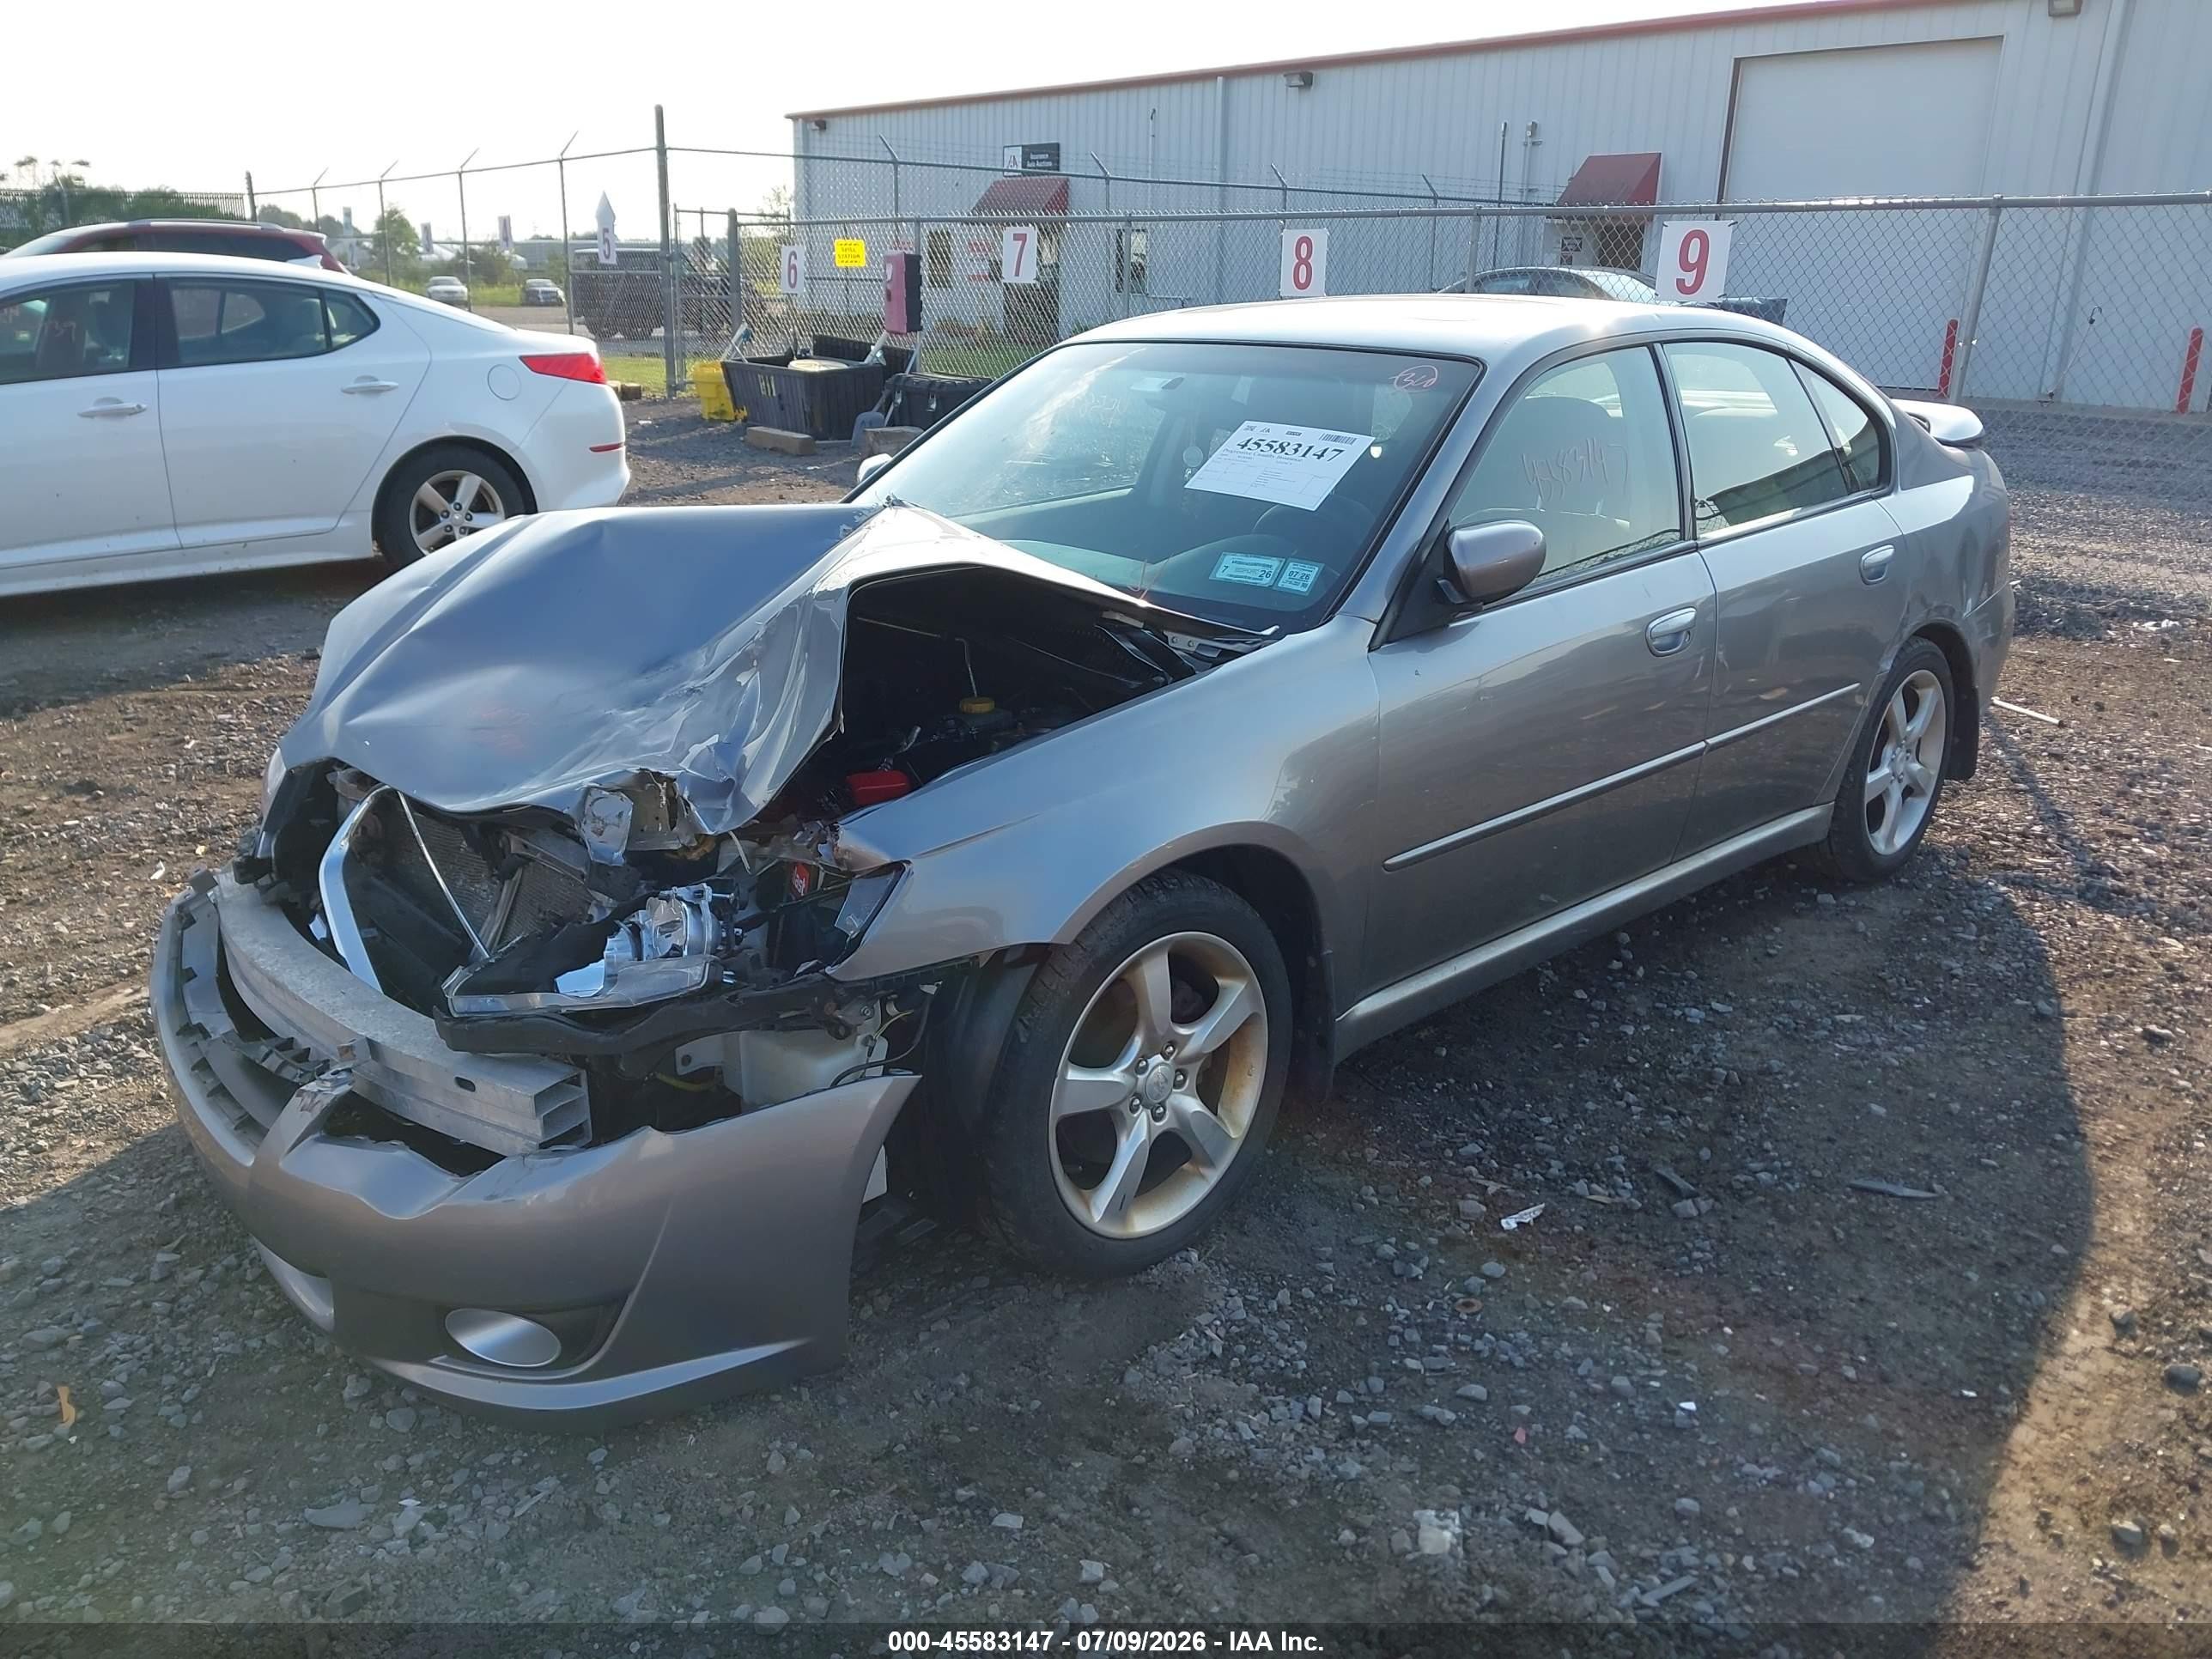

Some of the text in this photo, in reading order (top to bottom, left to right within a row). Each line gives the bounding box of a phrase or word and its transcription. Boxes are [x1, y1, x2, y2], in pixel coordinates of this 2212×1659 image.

[603, 228, 611, 259] 5
[1013, 233, 1027, 276] 7
[1293, 235, 1313, 290] 8
[1675, 229, 1710, 295] 9
[787, 250, 798, 289] 6
[1237, 436, 1346, 462] 45583147
[1222, 565, 1229, 574] 7
[1258, 569, 1273, 579] 26
